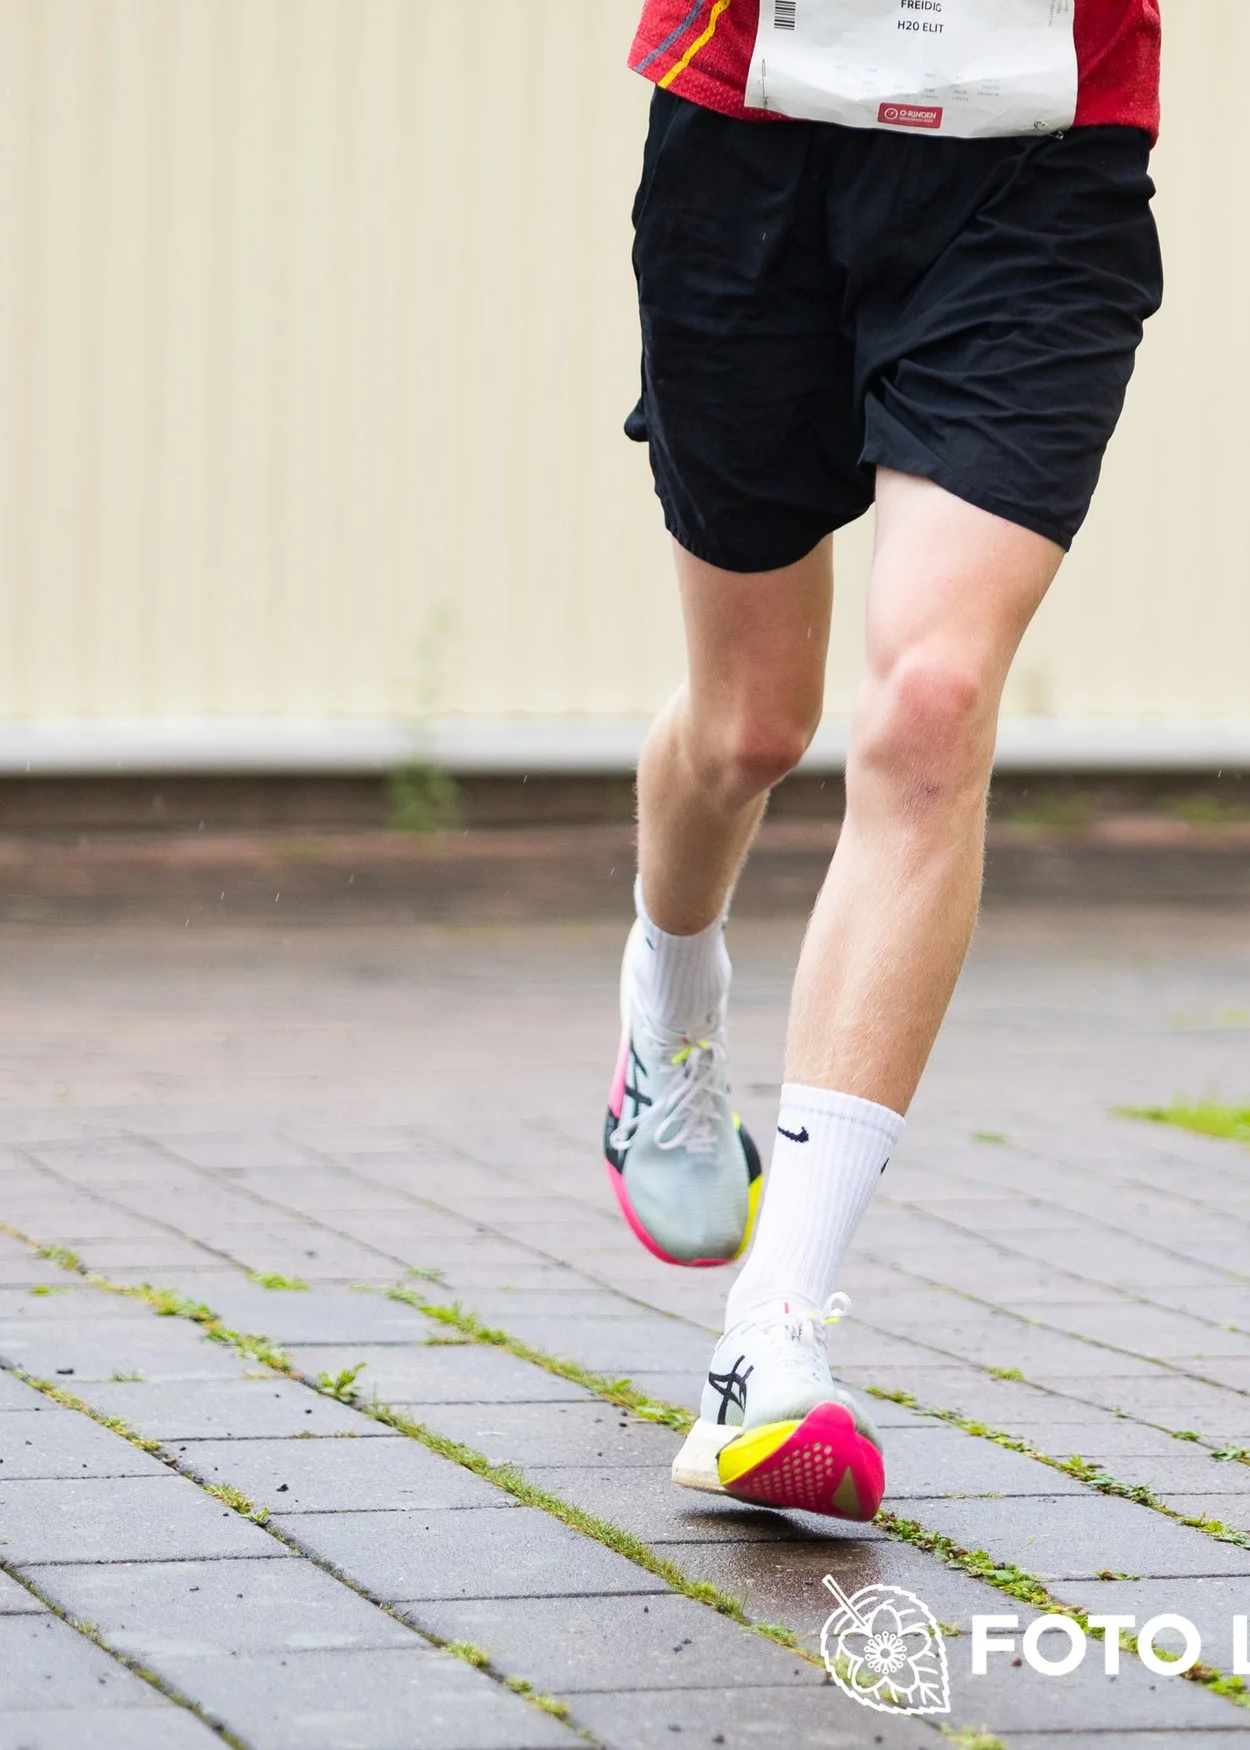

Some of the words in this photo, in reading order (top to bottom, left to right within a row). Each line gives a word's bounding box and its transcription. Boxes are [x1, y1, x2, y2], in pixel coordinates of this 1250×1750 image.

[897, 19, 920, 32] H20
[922, 21, 945, 34] ELIT
[900, 109, 937, 120] O-RINGEN
